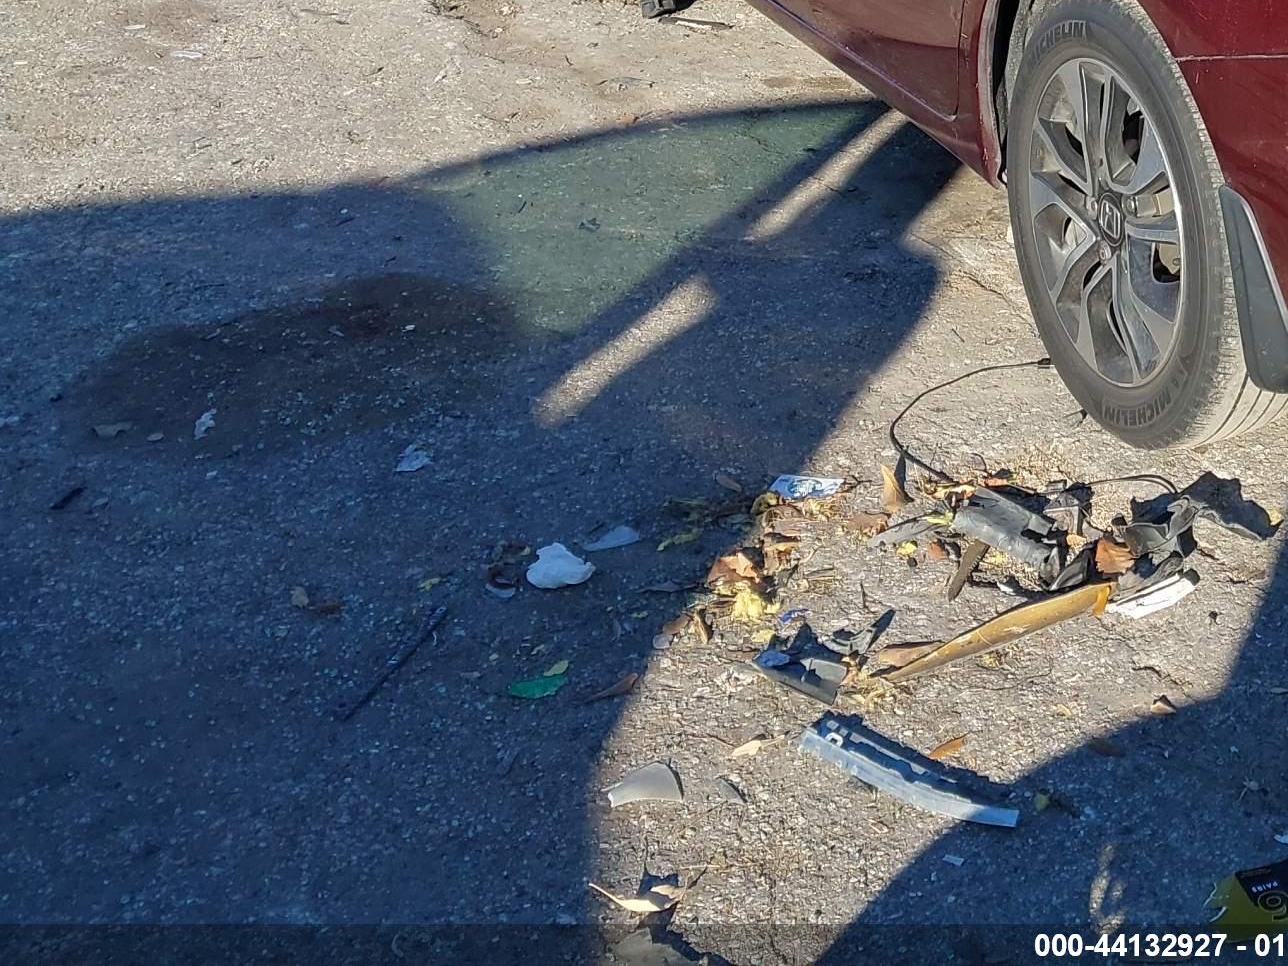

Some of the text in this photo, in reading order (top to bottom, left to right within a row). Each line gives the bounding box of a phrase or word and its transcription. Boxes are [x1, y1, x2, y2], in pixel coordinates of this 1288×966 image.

[1029, 19, 1088, 68] MICHELIN
[1102, 385, 1172, 427] MICHELIN
[1251, 881, 1278, 893] PAIRS
